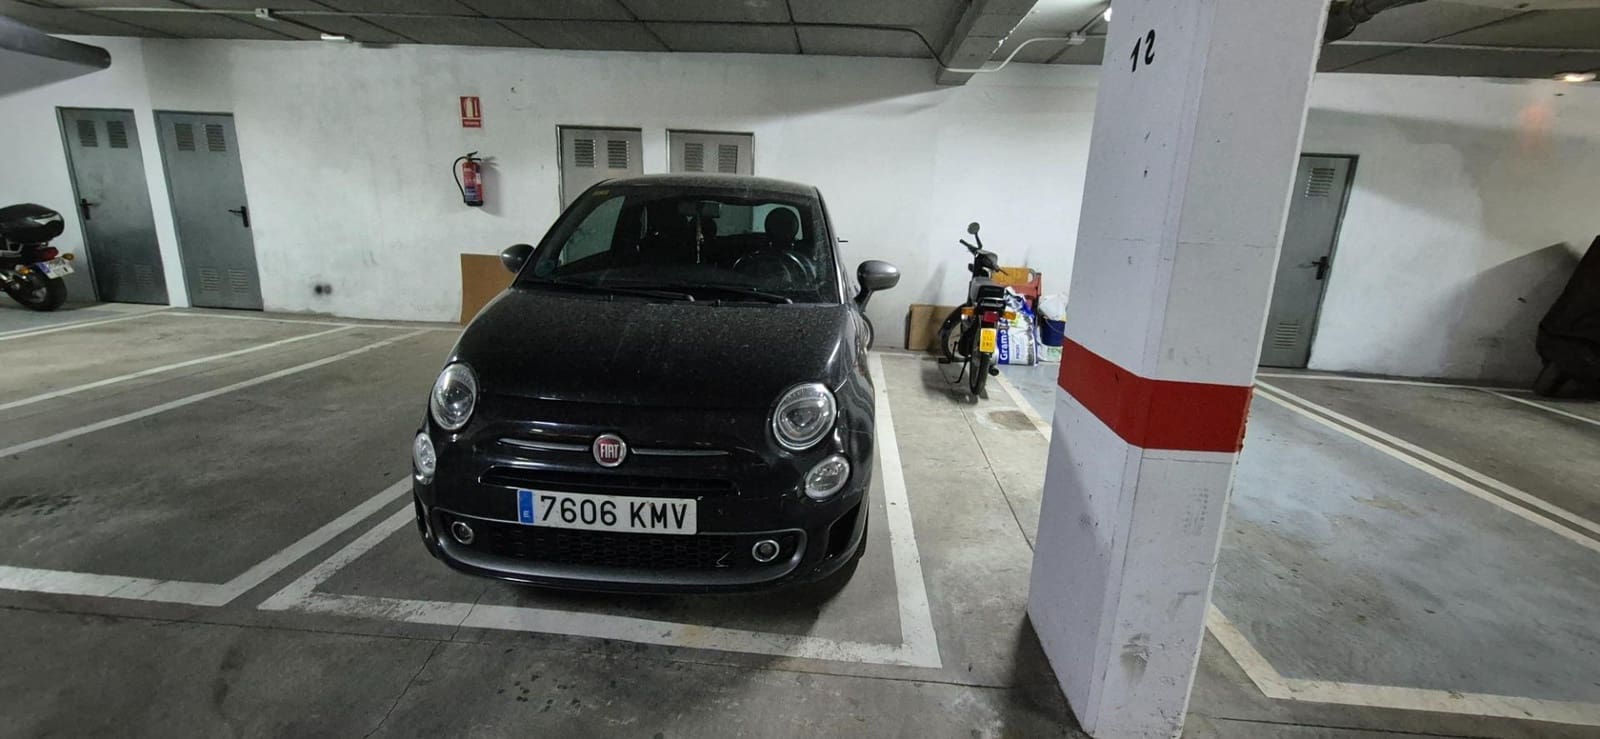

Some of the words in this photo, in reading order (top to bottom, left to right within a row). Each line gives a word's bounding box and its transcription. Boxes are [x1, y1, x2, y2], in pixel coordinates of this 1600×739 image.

[1130, 29, 1155, 72] 12
[600, 443, 620, 458] FIAT
[540, 495, 617, 527] 7606
[630, 501, 687, 529] KMV
